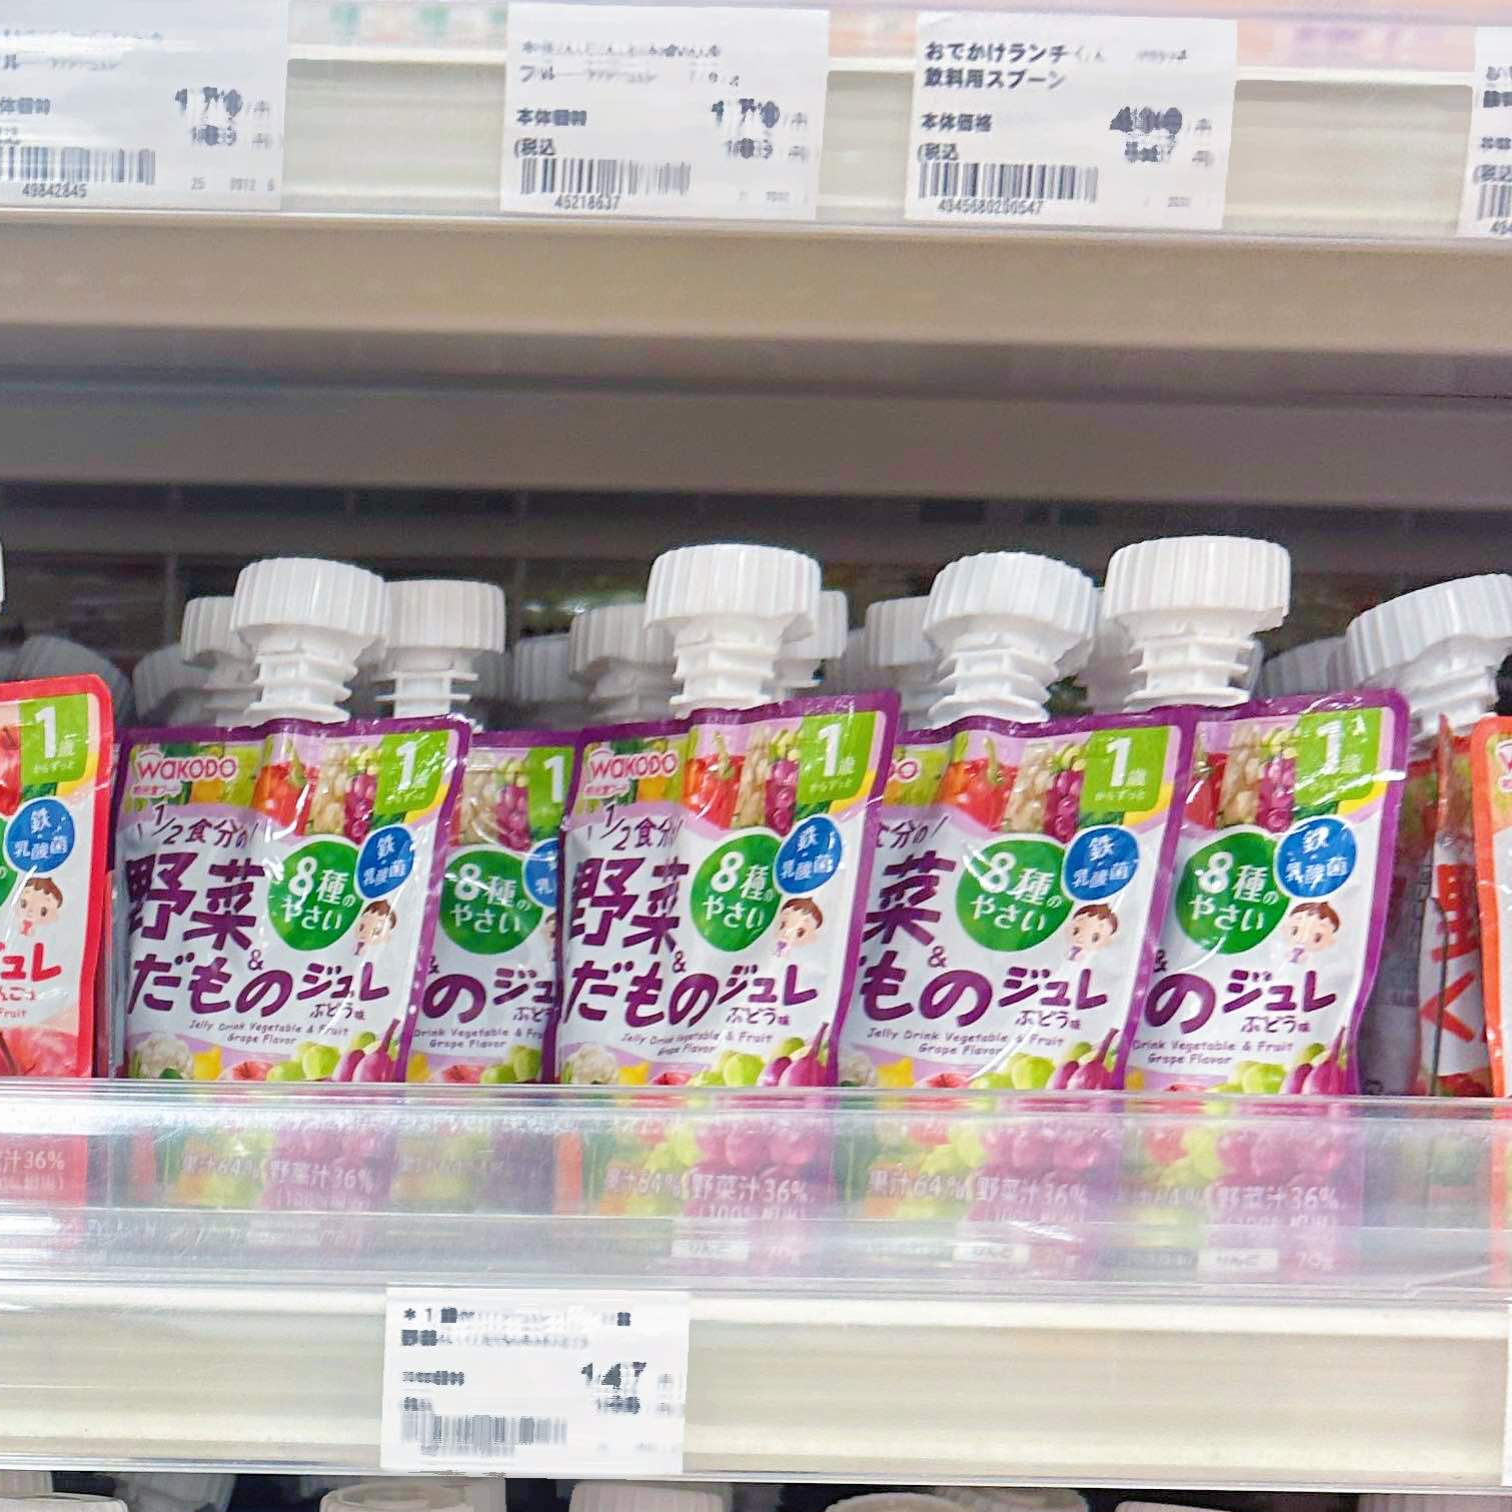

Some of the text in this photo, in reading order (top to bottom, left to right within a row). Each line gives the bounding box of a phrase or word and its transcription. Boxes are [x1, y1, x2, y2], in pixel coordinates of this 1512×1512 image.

[14, 838, 67, 860] 乳酸菌
[1197, 851, 1279, 906] 8種の
[126, 852, 266, 951] 野菜
[572, 856, 689, 956] 野菜
[703, 896, 766, 929] やさい
[863, 850, 957, 947] 菜
[970, 898, 1046, 933] やさい
[1190, 894, 1265, 931] やさい
[280, 901, 342, 931] やさい
[450, 903, 520, 934] やさい
[248, 949, 264, 971] &
[928, 945, 947, 968] &
